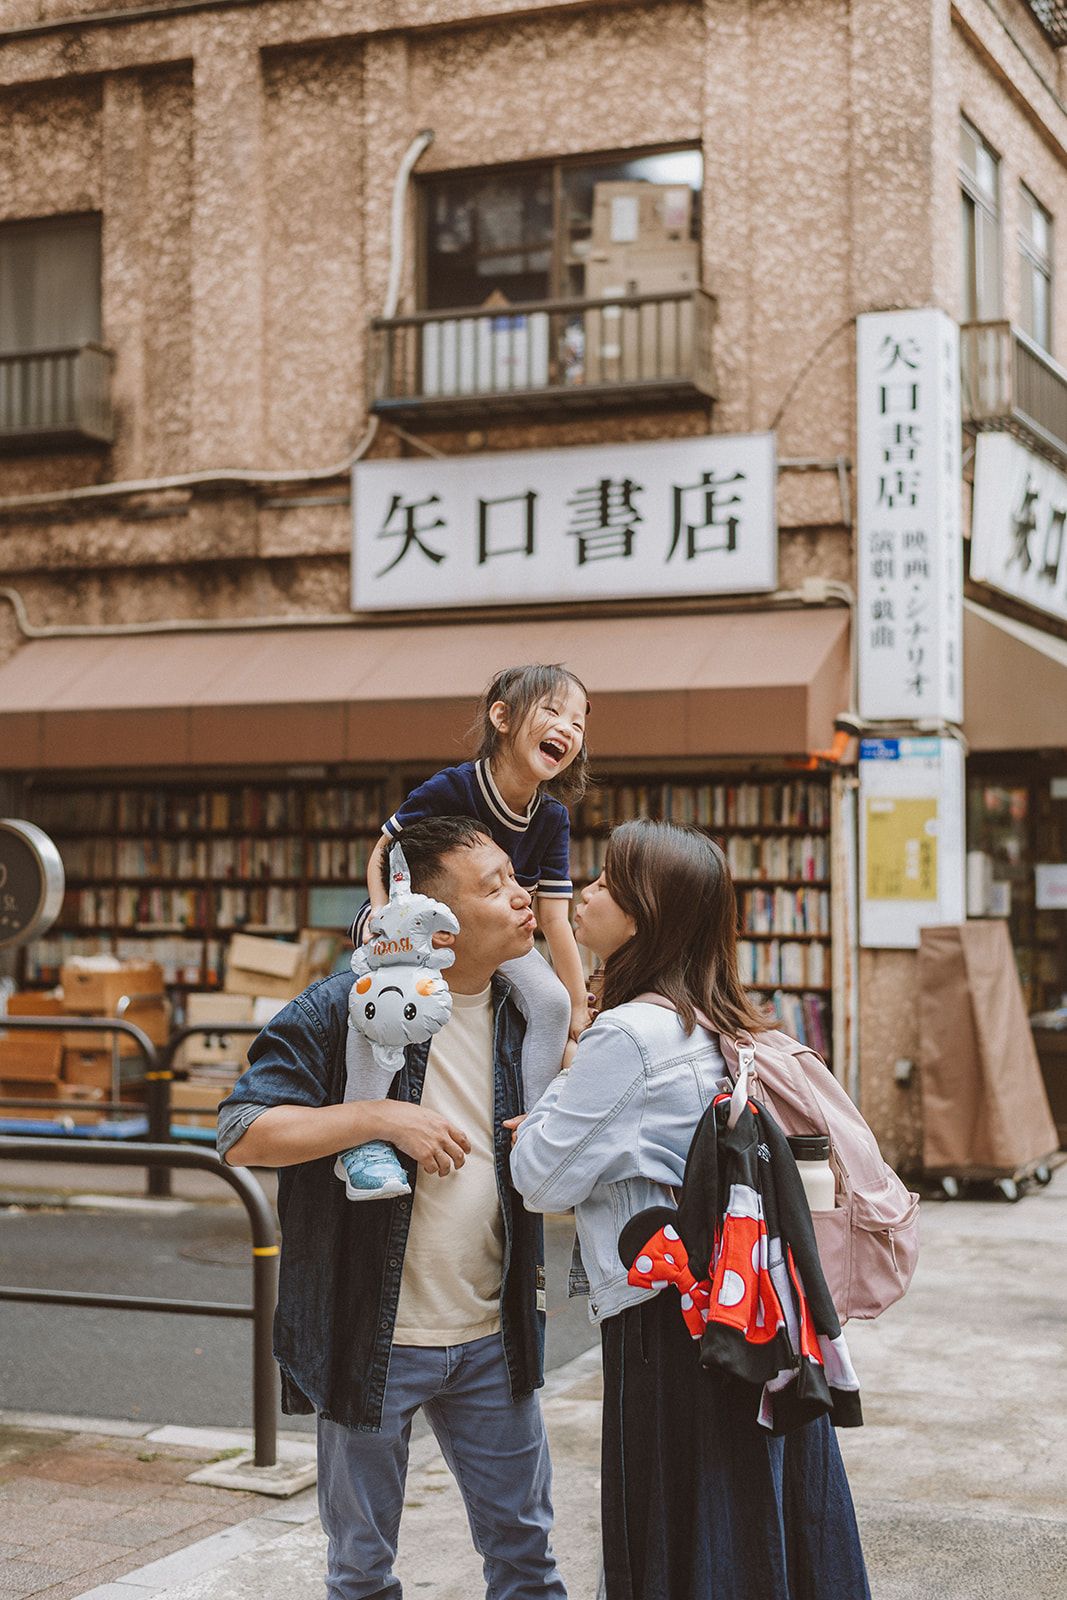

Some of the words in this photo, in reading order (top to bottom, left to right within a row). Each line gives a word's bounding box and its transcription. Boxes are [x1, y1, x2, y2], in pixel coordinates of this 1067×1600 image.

[877, 334, 921, 509] 矢口書店
[375, 471, 747, 579] 矢口書店
